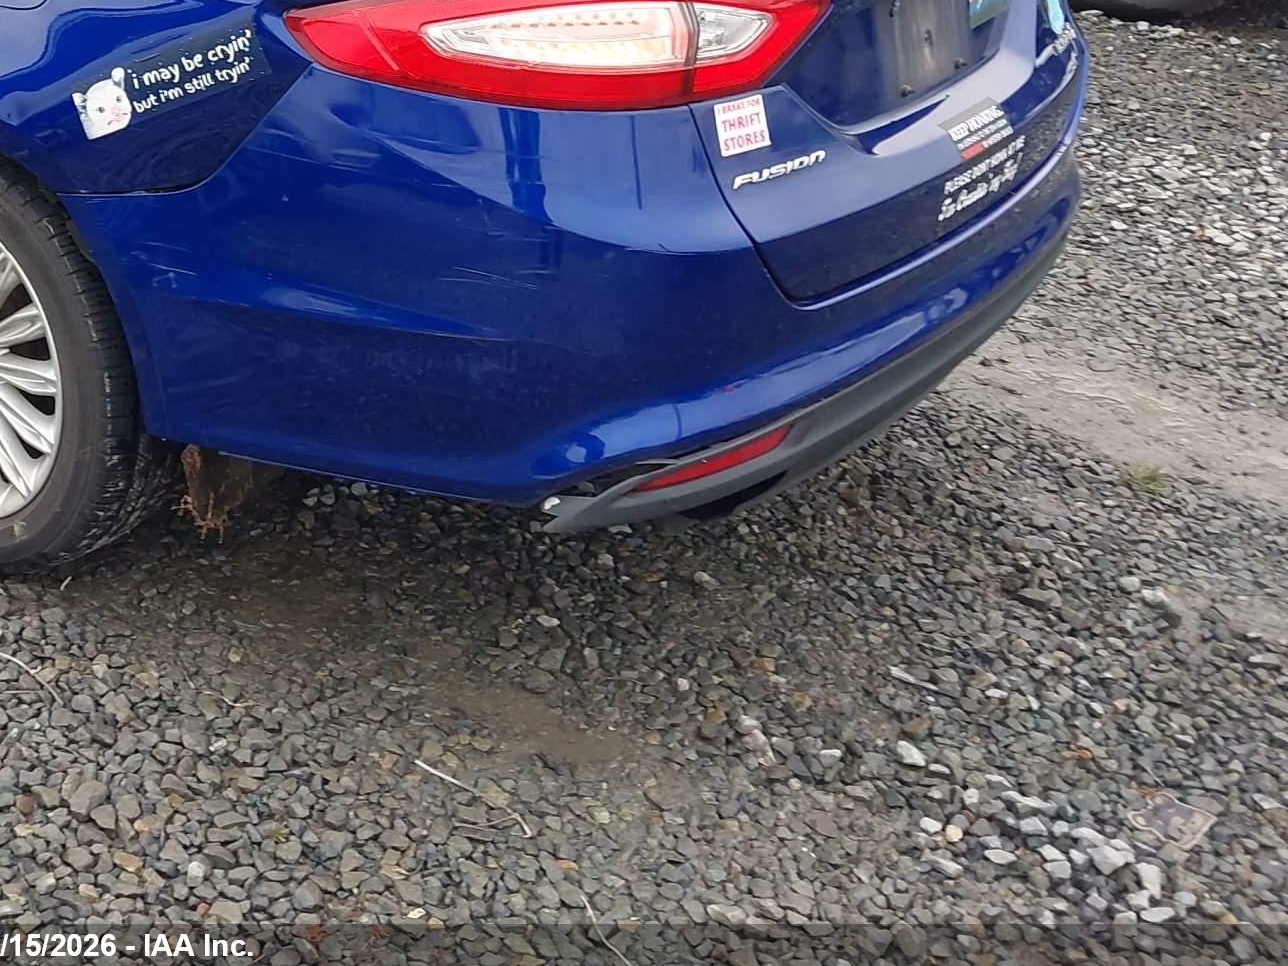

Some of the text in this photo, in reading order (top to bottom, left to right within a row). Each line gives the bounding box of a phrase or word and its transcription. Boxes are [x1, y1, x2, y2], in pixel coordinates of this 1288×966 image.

[132, 29, 252, 90] i may be cryin'
[133, 57, 250, 114] but i'm still tryin'
[721, 112, 762, 133] THRIFT
[723, 130, 767, 152] STORES
